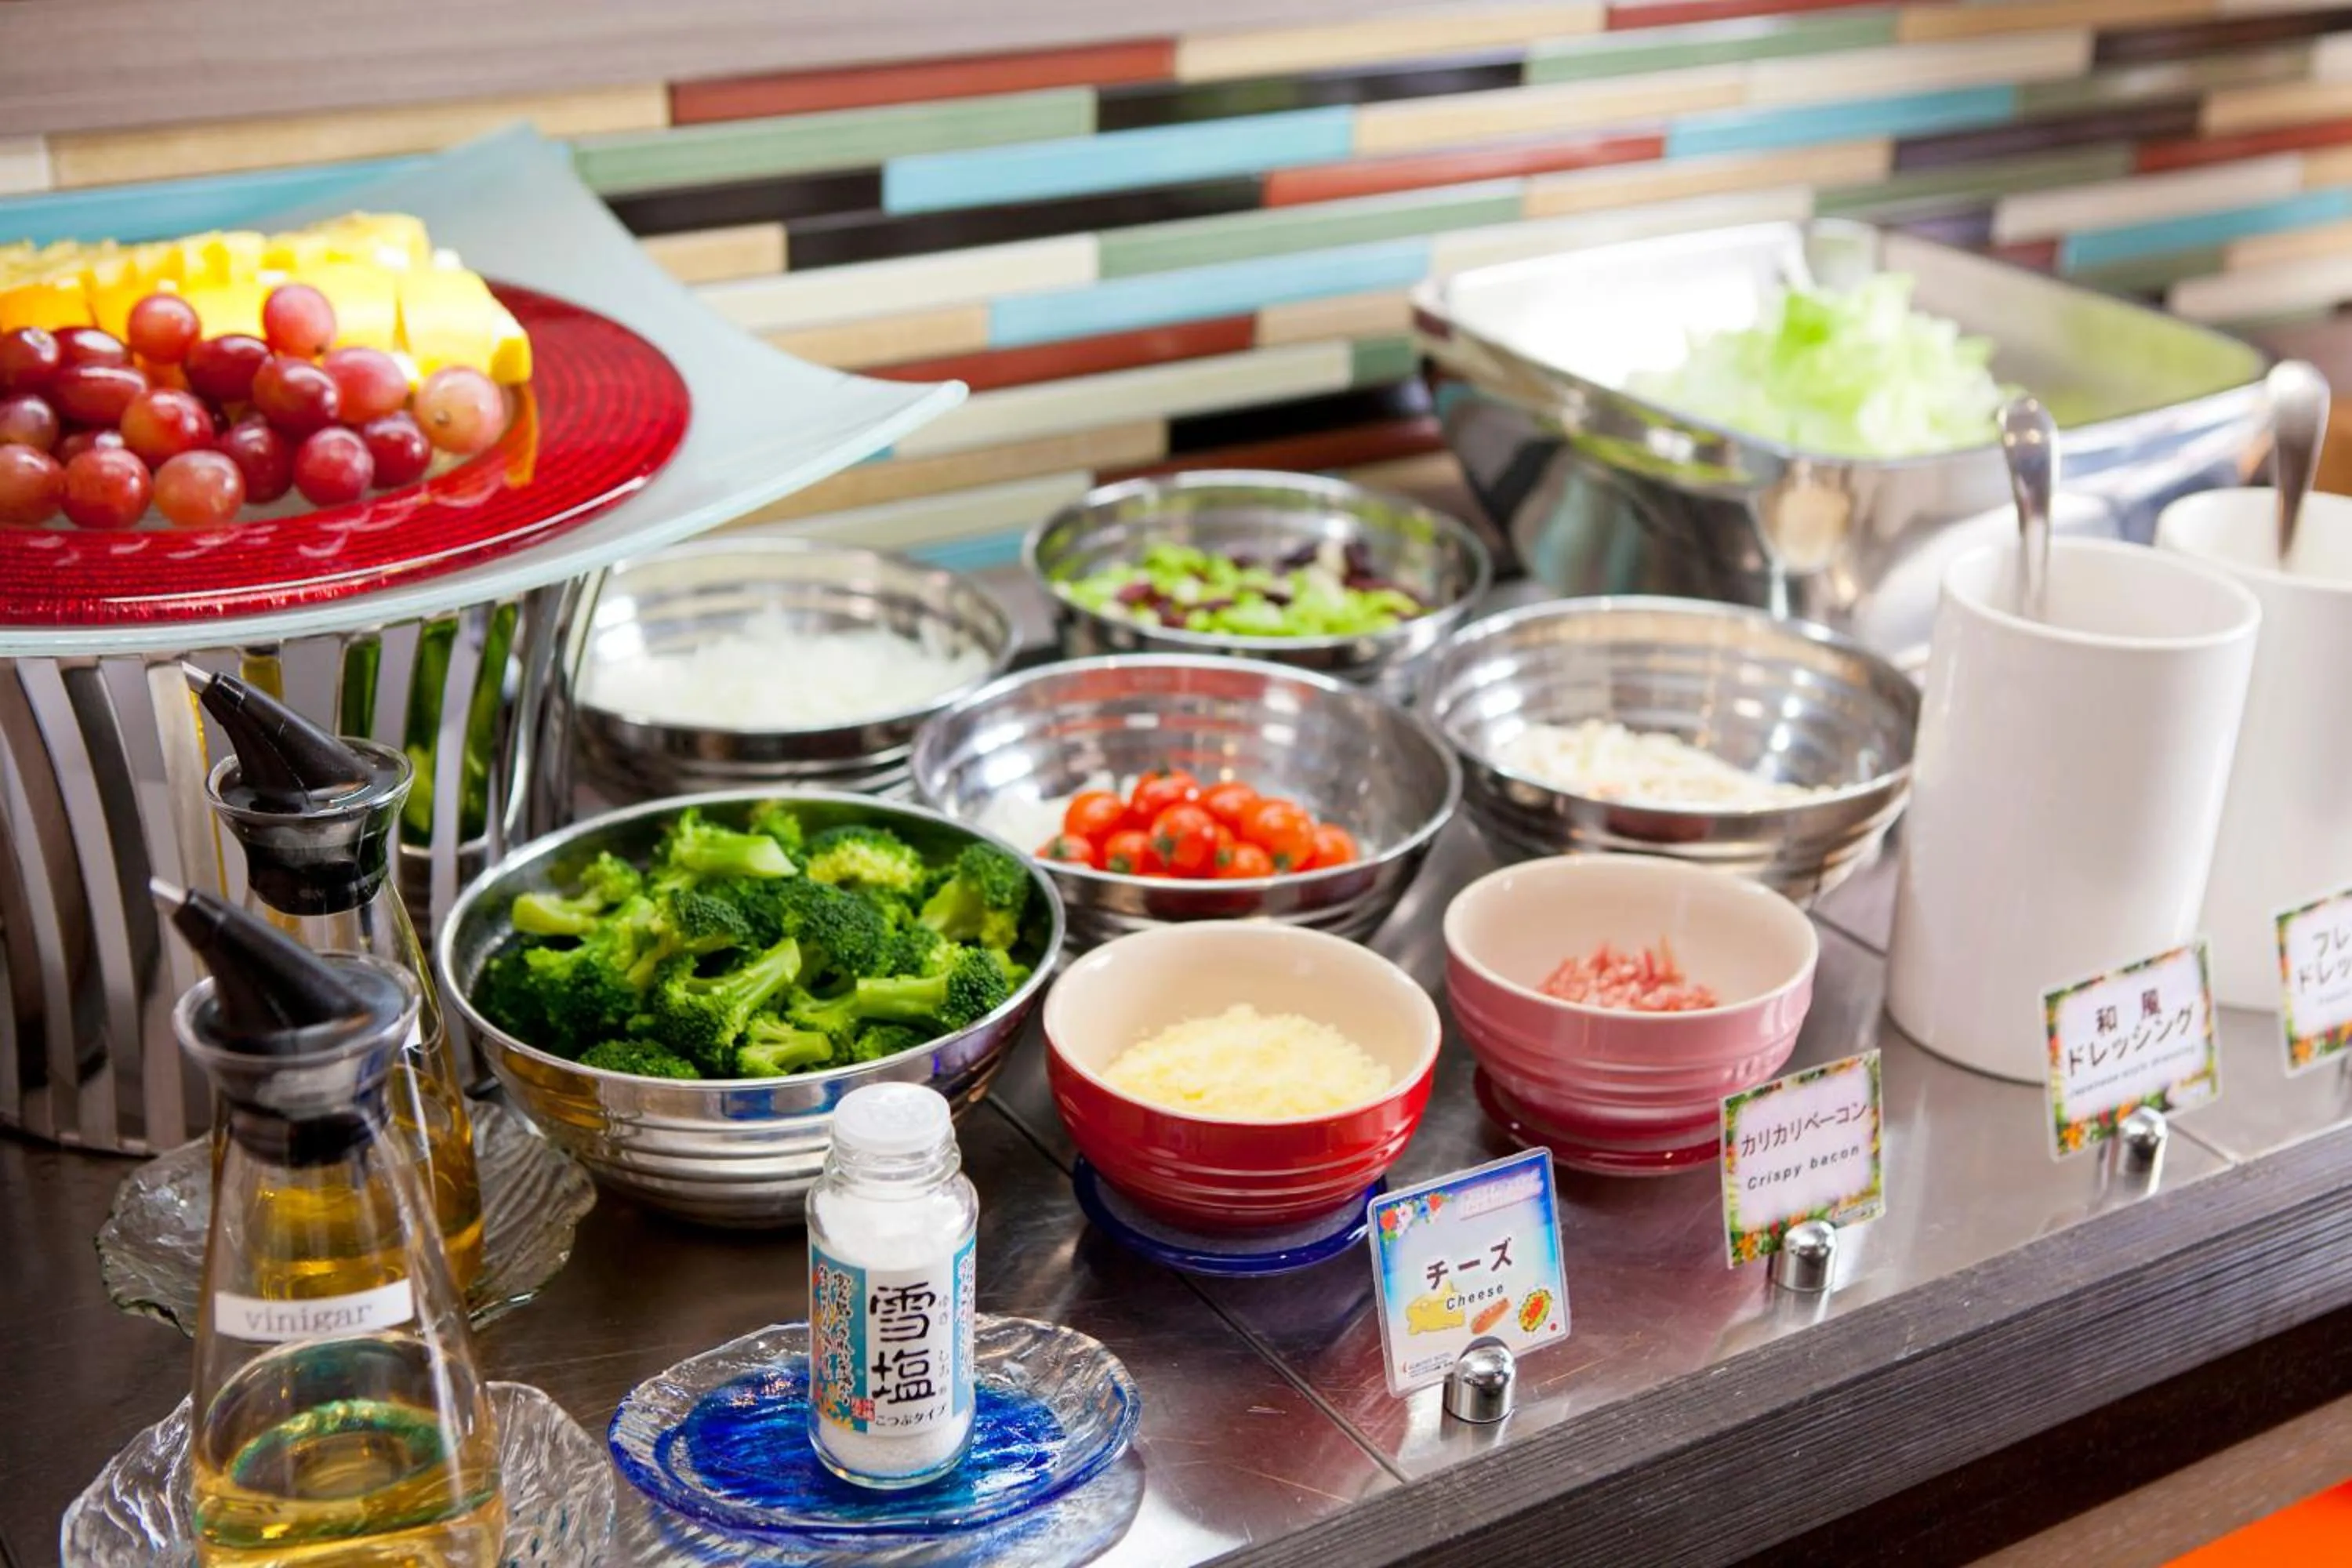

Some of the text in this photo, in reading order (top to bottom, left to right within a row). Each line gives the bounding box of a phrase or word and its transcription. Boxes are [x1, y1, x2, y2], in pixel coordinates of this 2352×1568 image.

[2096, 988, 2161, 1035] 和風
[2067, 1003, 2194, 1077] ドレッシング
[1740, 1102, 1868, 1158] カリカリベーコン
[1747, 1144, 1860, 1191] Crispy bacon
[1425, 1236, 1513, 1290] チーズ
[245, 1304, 373, 1332] vinigar
[1446, 1283, 1504, 1311] Cheese
[869, 1280, 937, 1406] 雪塩
